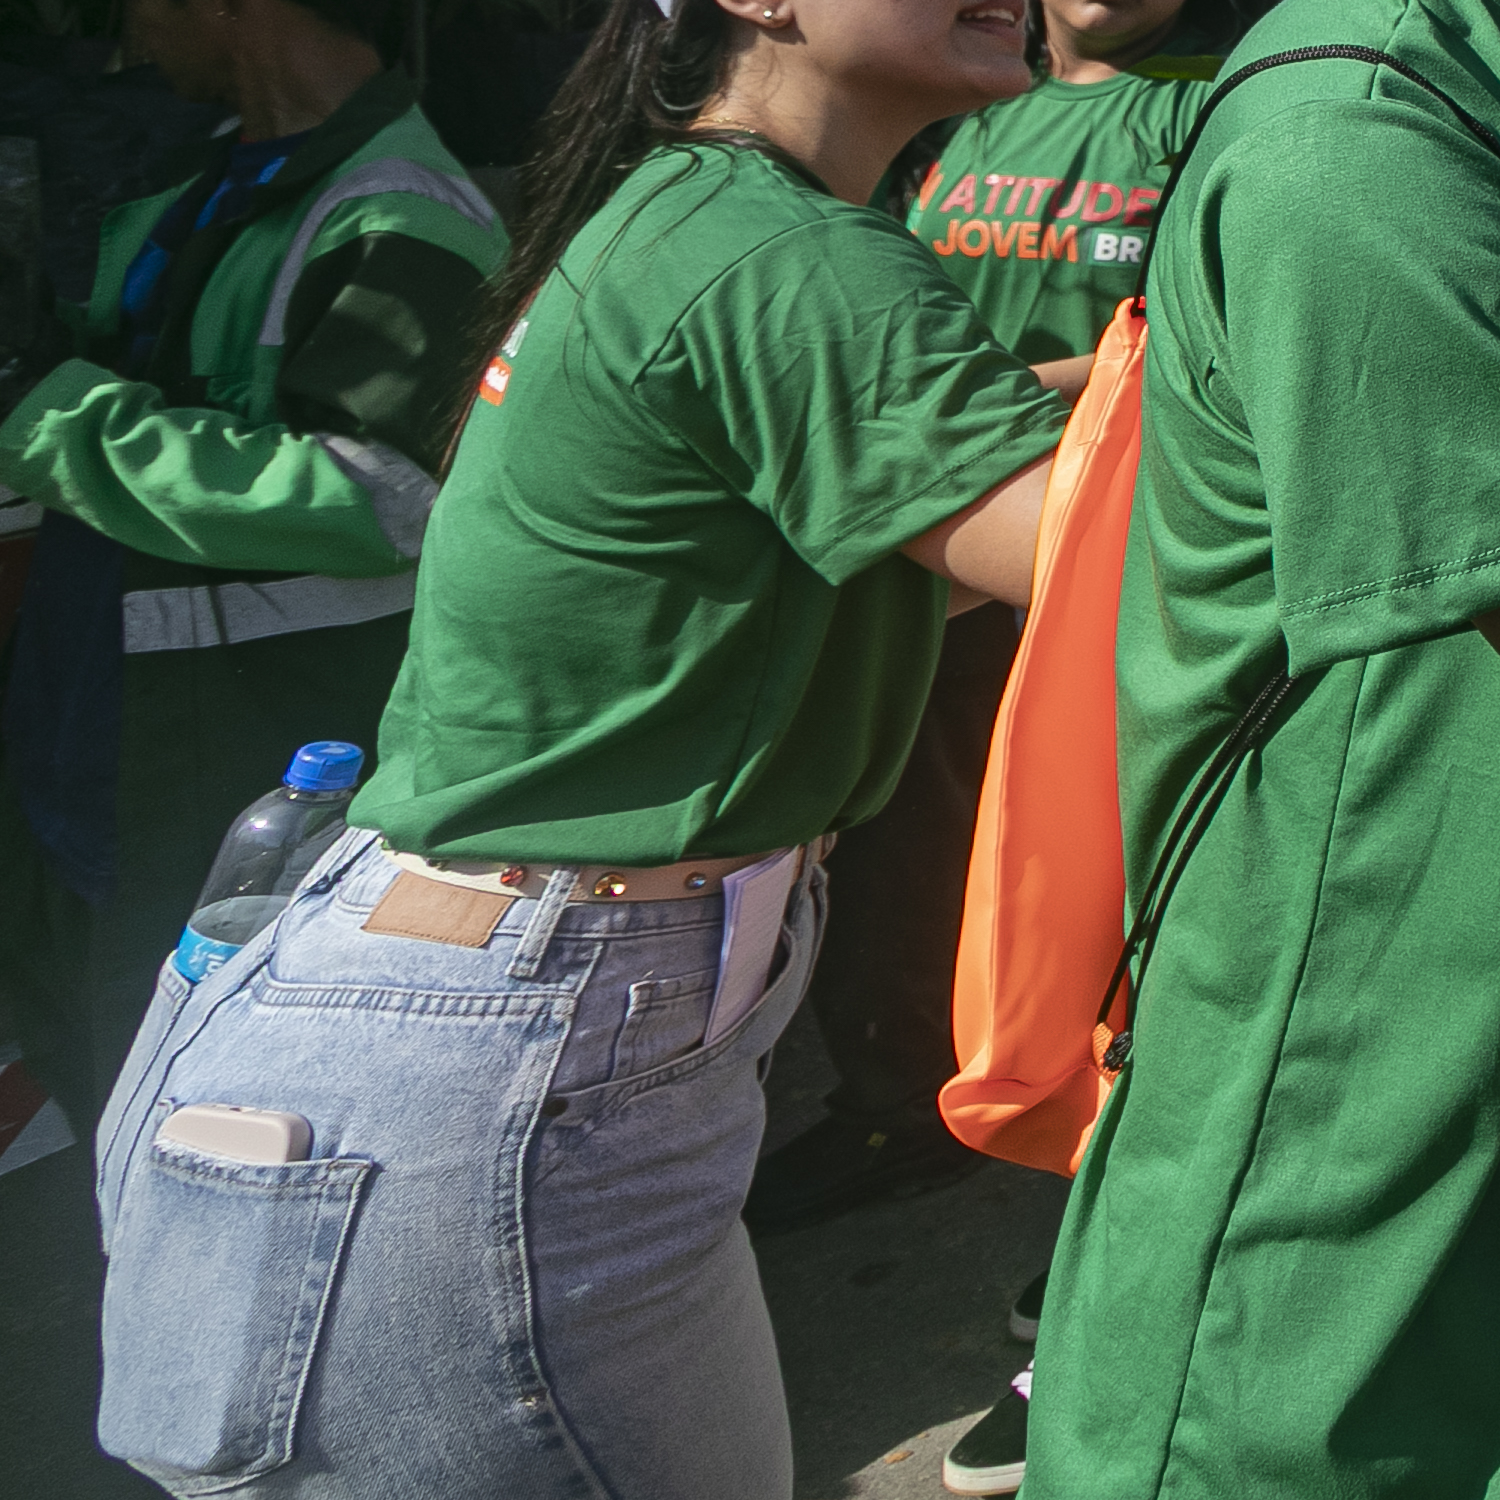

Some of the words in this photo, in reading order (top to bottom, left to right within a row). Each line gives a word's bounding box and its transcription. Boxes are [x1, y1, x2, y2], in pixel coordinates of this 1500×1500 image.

[939, 174, 1161, 226] ATITUDE
[932, 219, 1078, 263] JOVEM
[1093, 233, 1143, 263] BR
